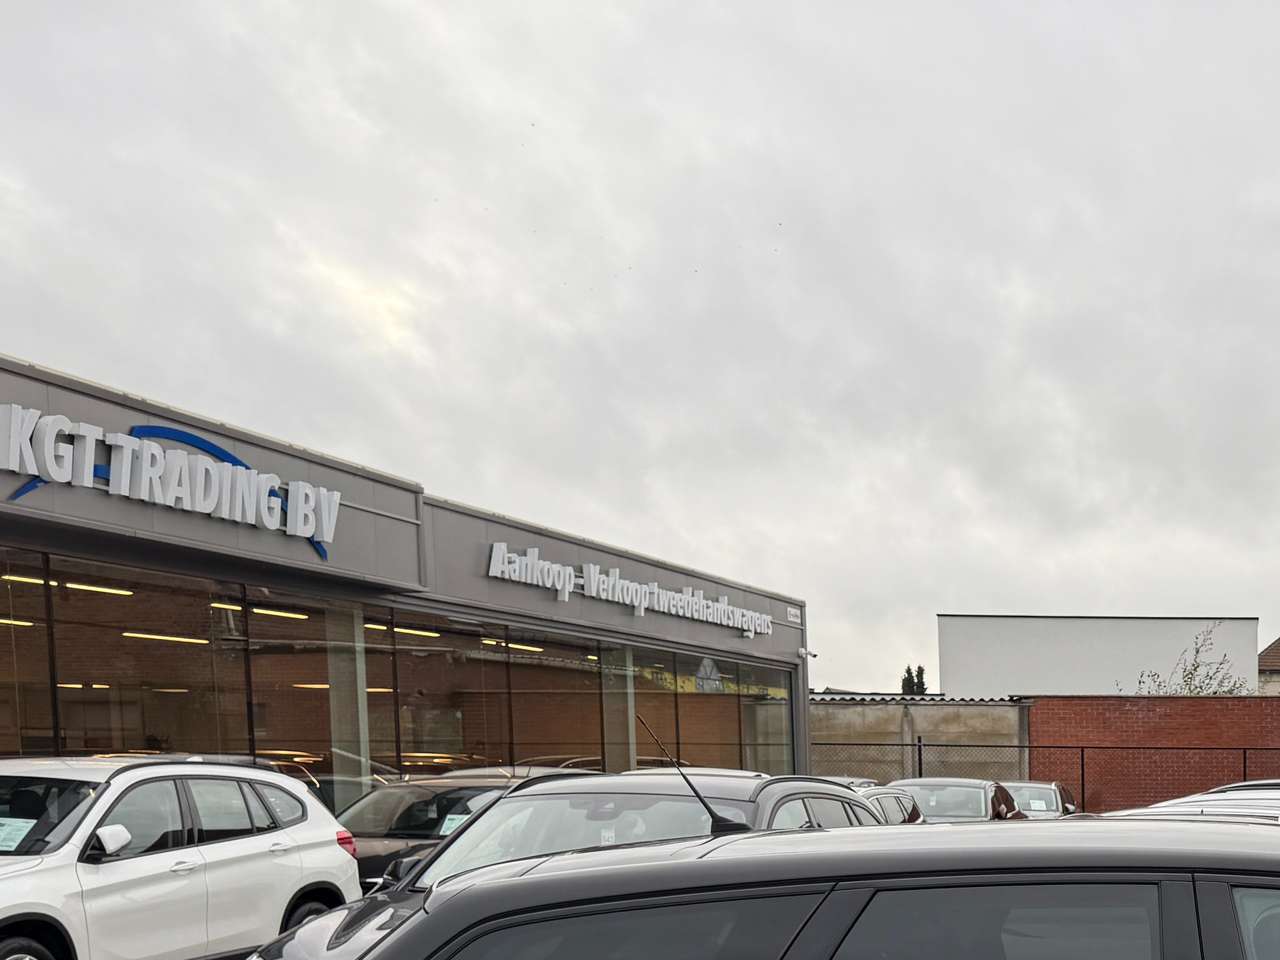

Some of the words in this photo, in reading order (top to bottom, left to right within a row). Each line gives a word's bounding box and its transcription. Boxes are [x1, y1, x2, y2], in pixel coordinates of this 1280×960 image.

[1, 403, 103, 487] KGT
[106, 432, 281, 530] TRADING
[287, 481, 341, 542] BV
[648, 582, 772, 639] tweedehandswagens
